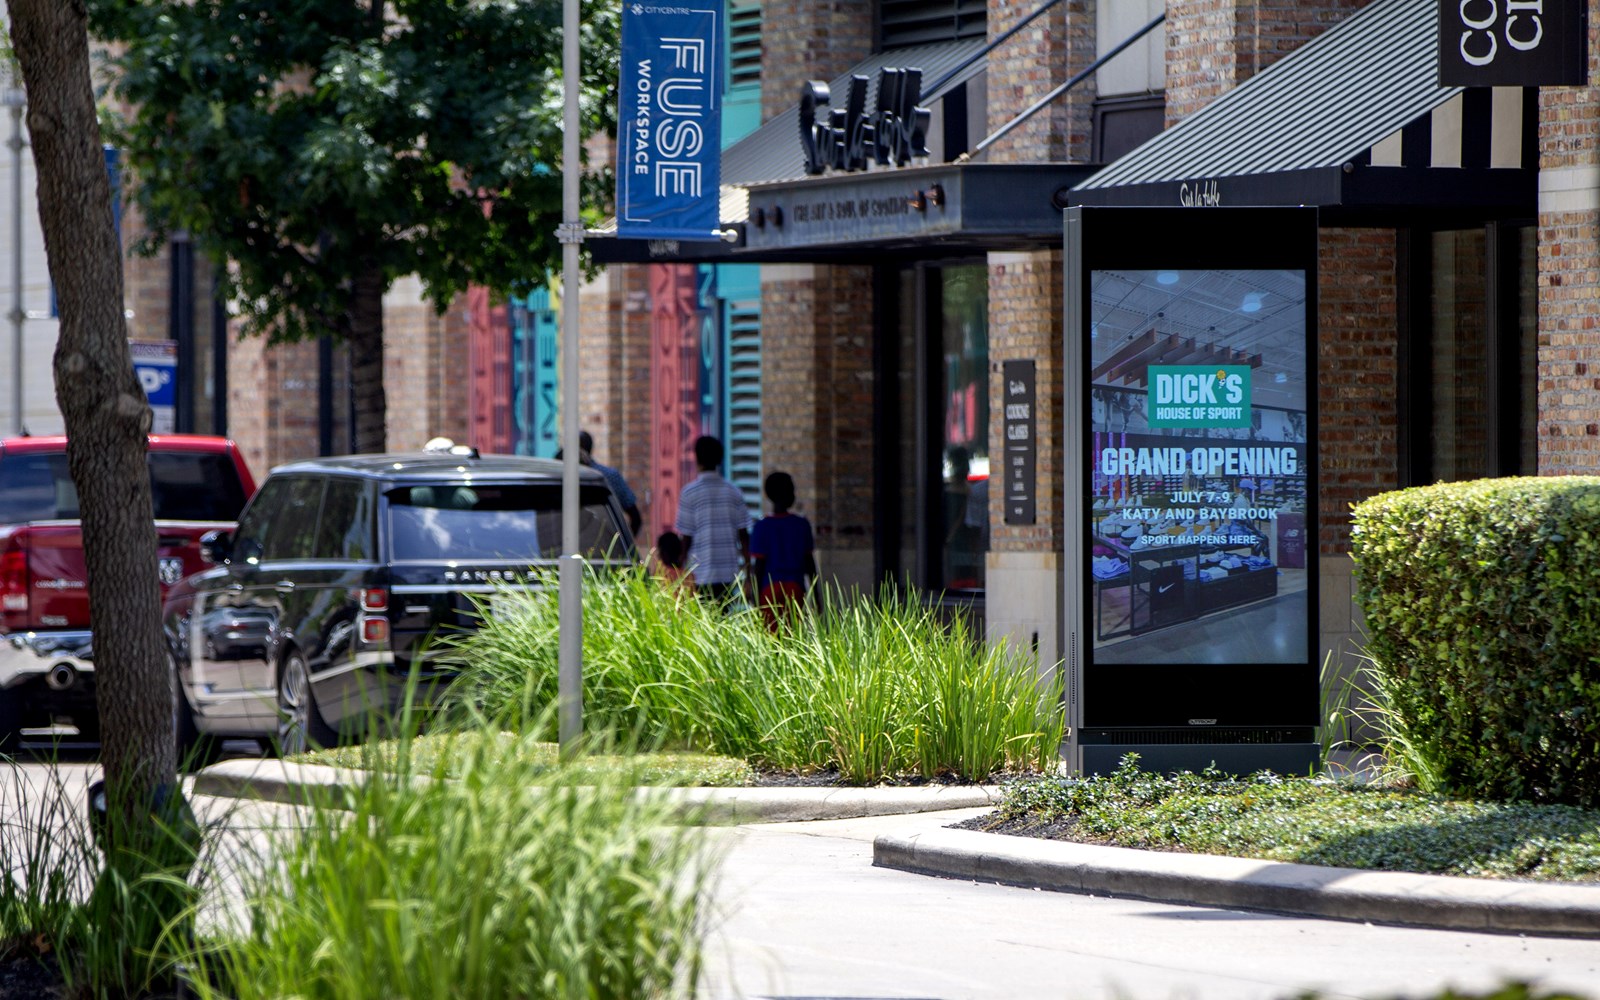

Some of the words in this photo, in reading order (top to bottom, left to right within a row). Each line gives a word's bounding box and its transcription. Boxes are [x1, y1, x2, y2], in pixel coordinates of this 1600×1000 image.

[644, 6, 690, 15] CITYCENTRE
[635, 59, 651, 175] WORKSPACE
[656, 37, 705, 198] FUSE
[1157, 370, 1243, 404] DICK'S
[1157, 407, 1191, 419] HOUSE
[1193, 407, 1206, 419] OF
[1208, 407, 1242, 419] SPORT
[1102, 447, 1186, 476] GRAND
[1191, 447, 1297, 476] OPENING
[1170, 491, 1202, 503] JULY
[1206, 491, 1231, 503] 7-9
[1123, 508, 1161, 519] KATY
[1165, 508, 1195, 519] AND
[1200, 508, 1278, 519] BAYBROOK
[1141, 535, 1176, 545] SPORT
[1178, 535, 1228, 545] HAPPENS
[1229, 535, 1260, 545] HERE.
[444, 570, 515, 581] RANGE
